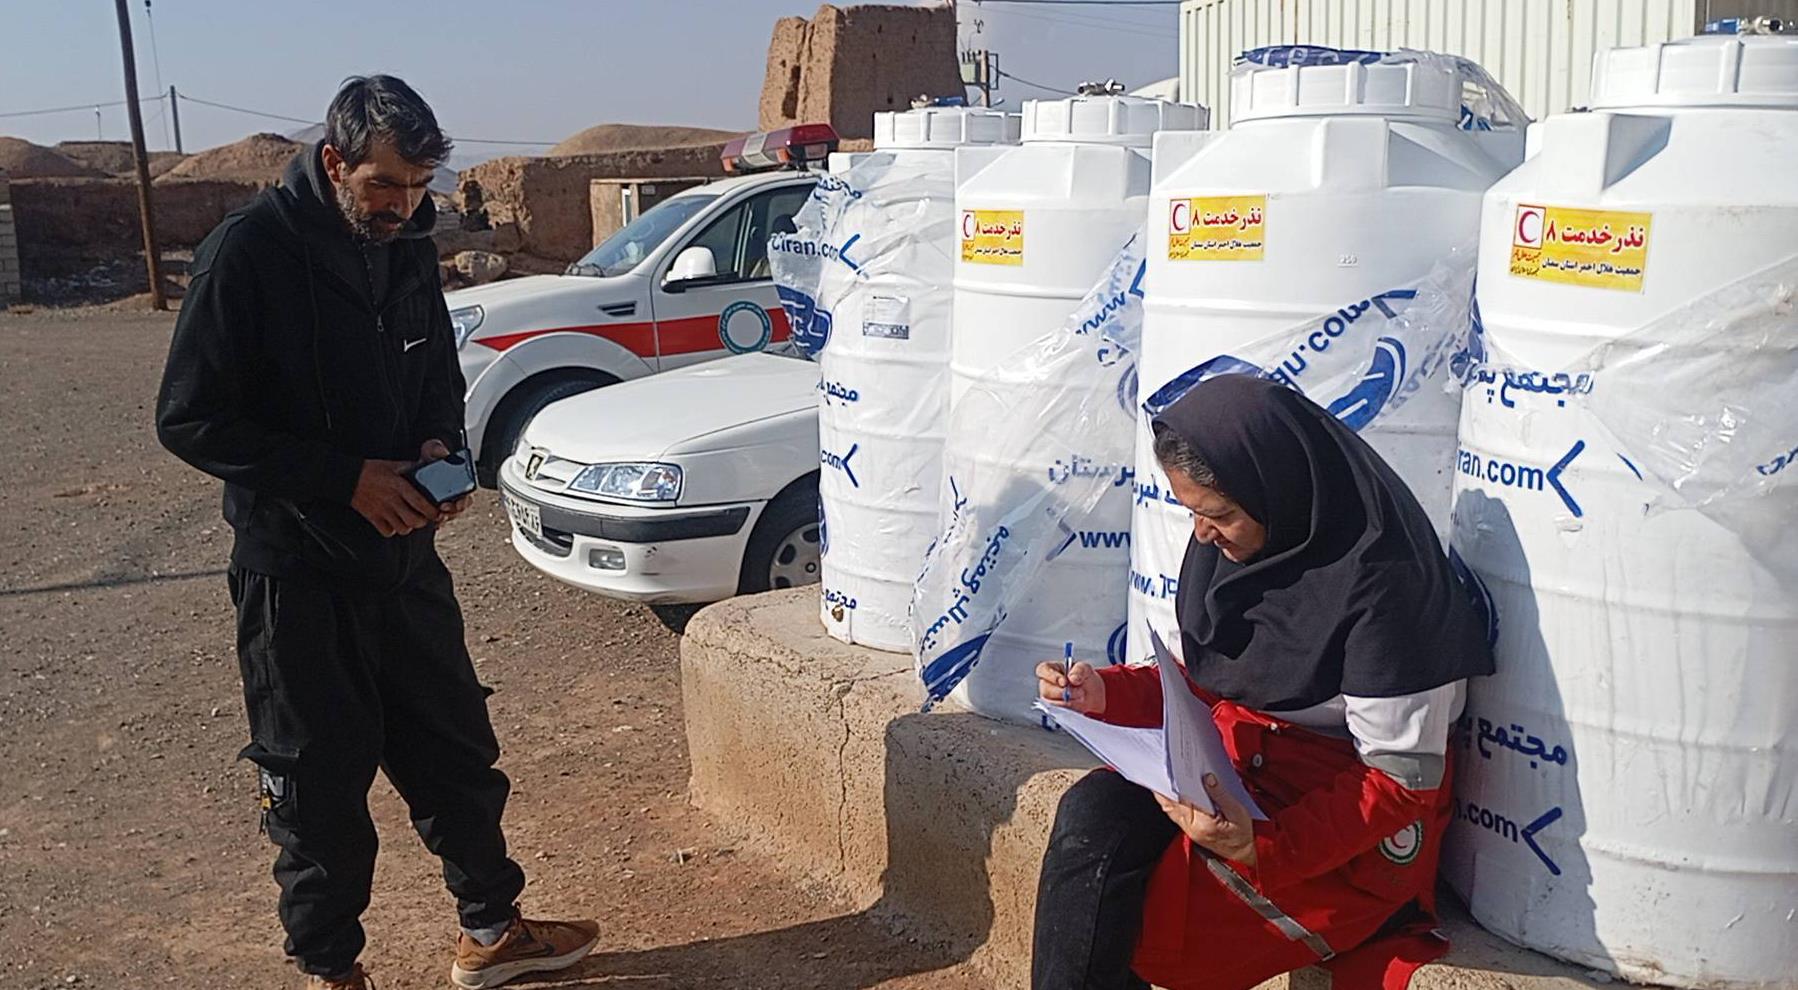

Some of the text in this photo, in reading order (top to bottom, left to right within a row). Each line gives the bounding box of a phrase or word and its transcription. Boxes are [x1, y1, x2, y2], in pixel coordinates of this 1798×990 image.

[1192, 208, 1262, 230] نذر خدمت ۸
[982, 224, 1006, 235] خدمت
[1006, 221, 1021, 240] نذر
[1546, 220, 1645, 252] نذر خدمت ۸
[1560, 260, 1578, 271] استان
[1580, 262, 1595, 273] احمر
[1596, 262, 1613, 275] هلال
[1614, 265, 1641, 276] جمعیت
[1477, 717, 1567, 770] مجتمع
